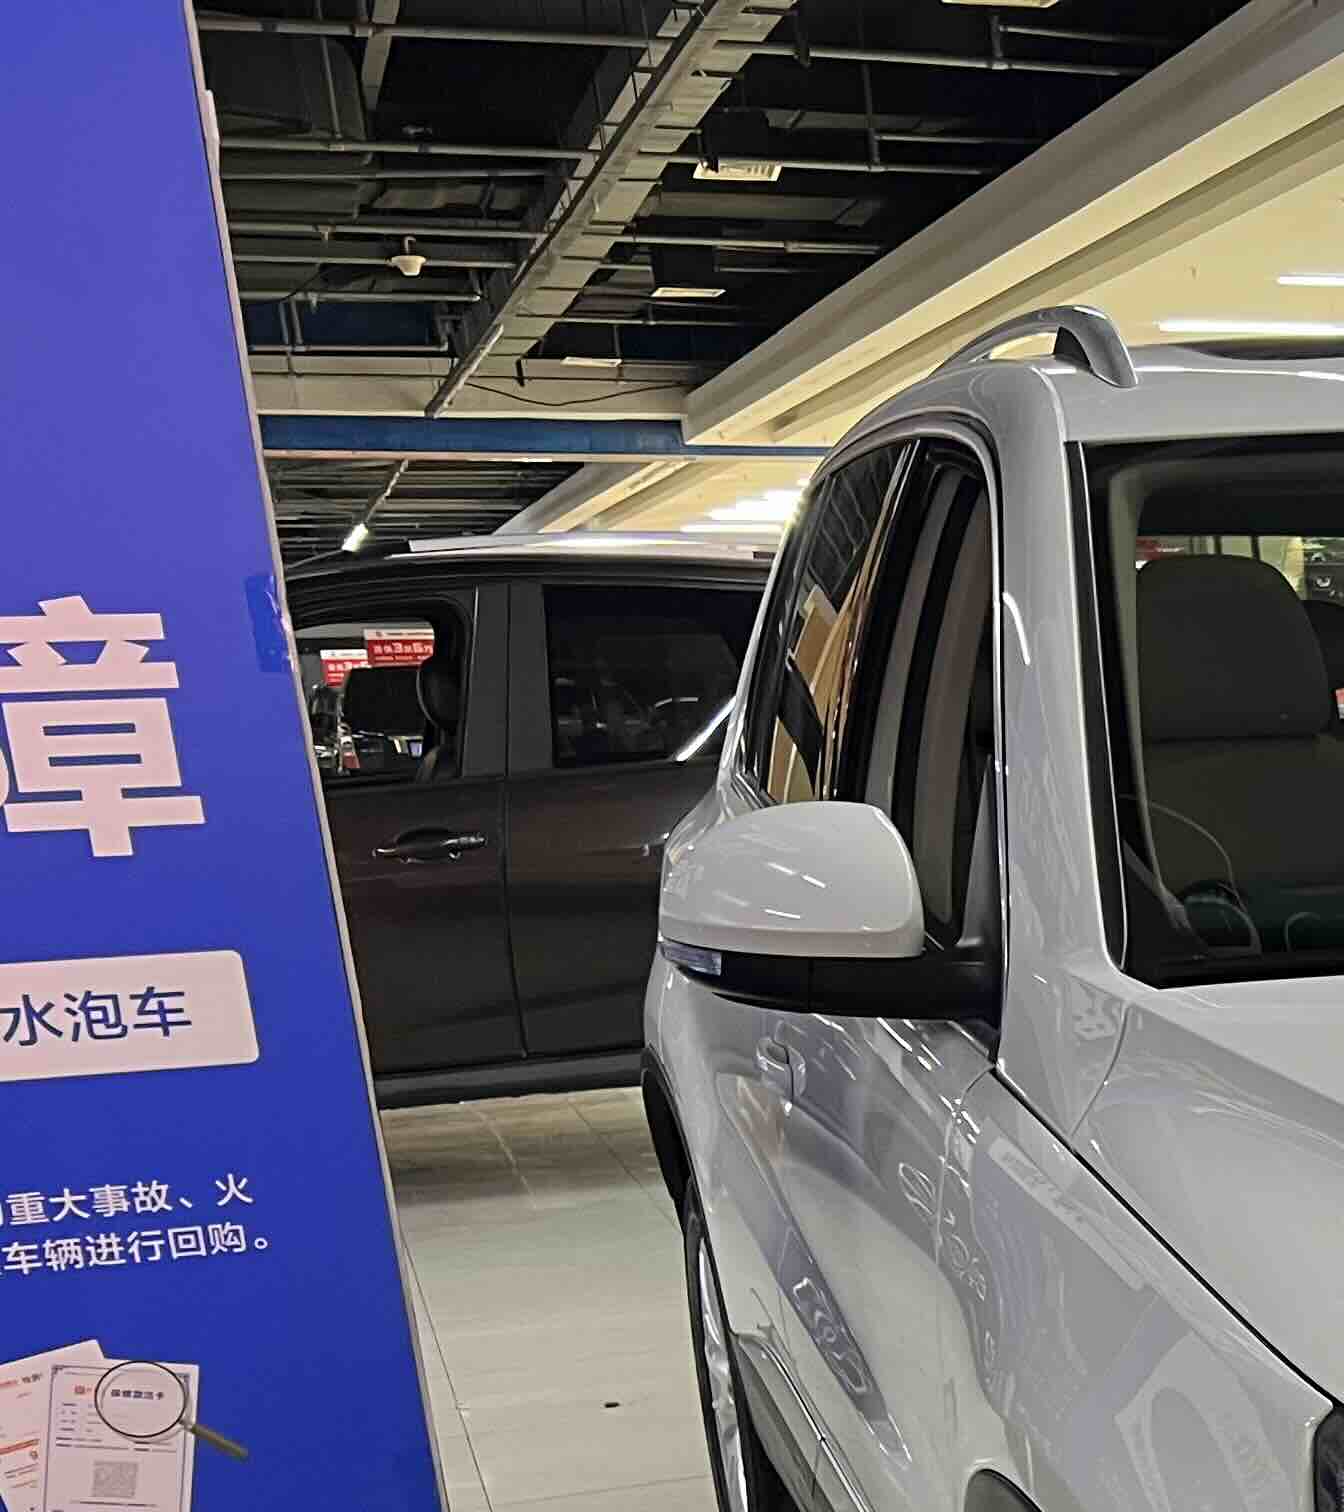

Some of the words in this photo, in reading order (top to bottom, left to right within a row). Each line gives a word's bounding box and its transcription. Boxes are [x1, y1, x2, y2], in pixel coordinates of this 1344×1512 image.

[0, 986, 192, 1046] 水泡车
[0, 1173, 254, 1226] 重大事故、火
[0, 1222, 269, 1277] 车辆进行回购。
